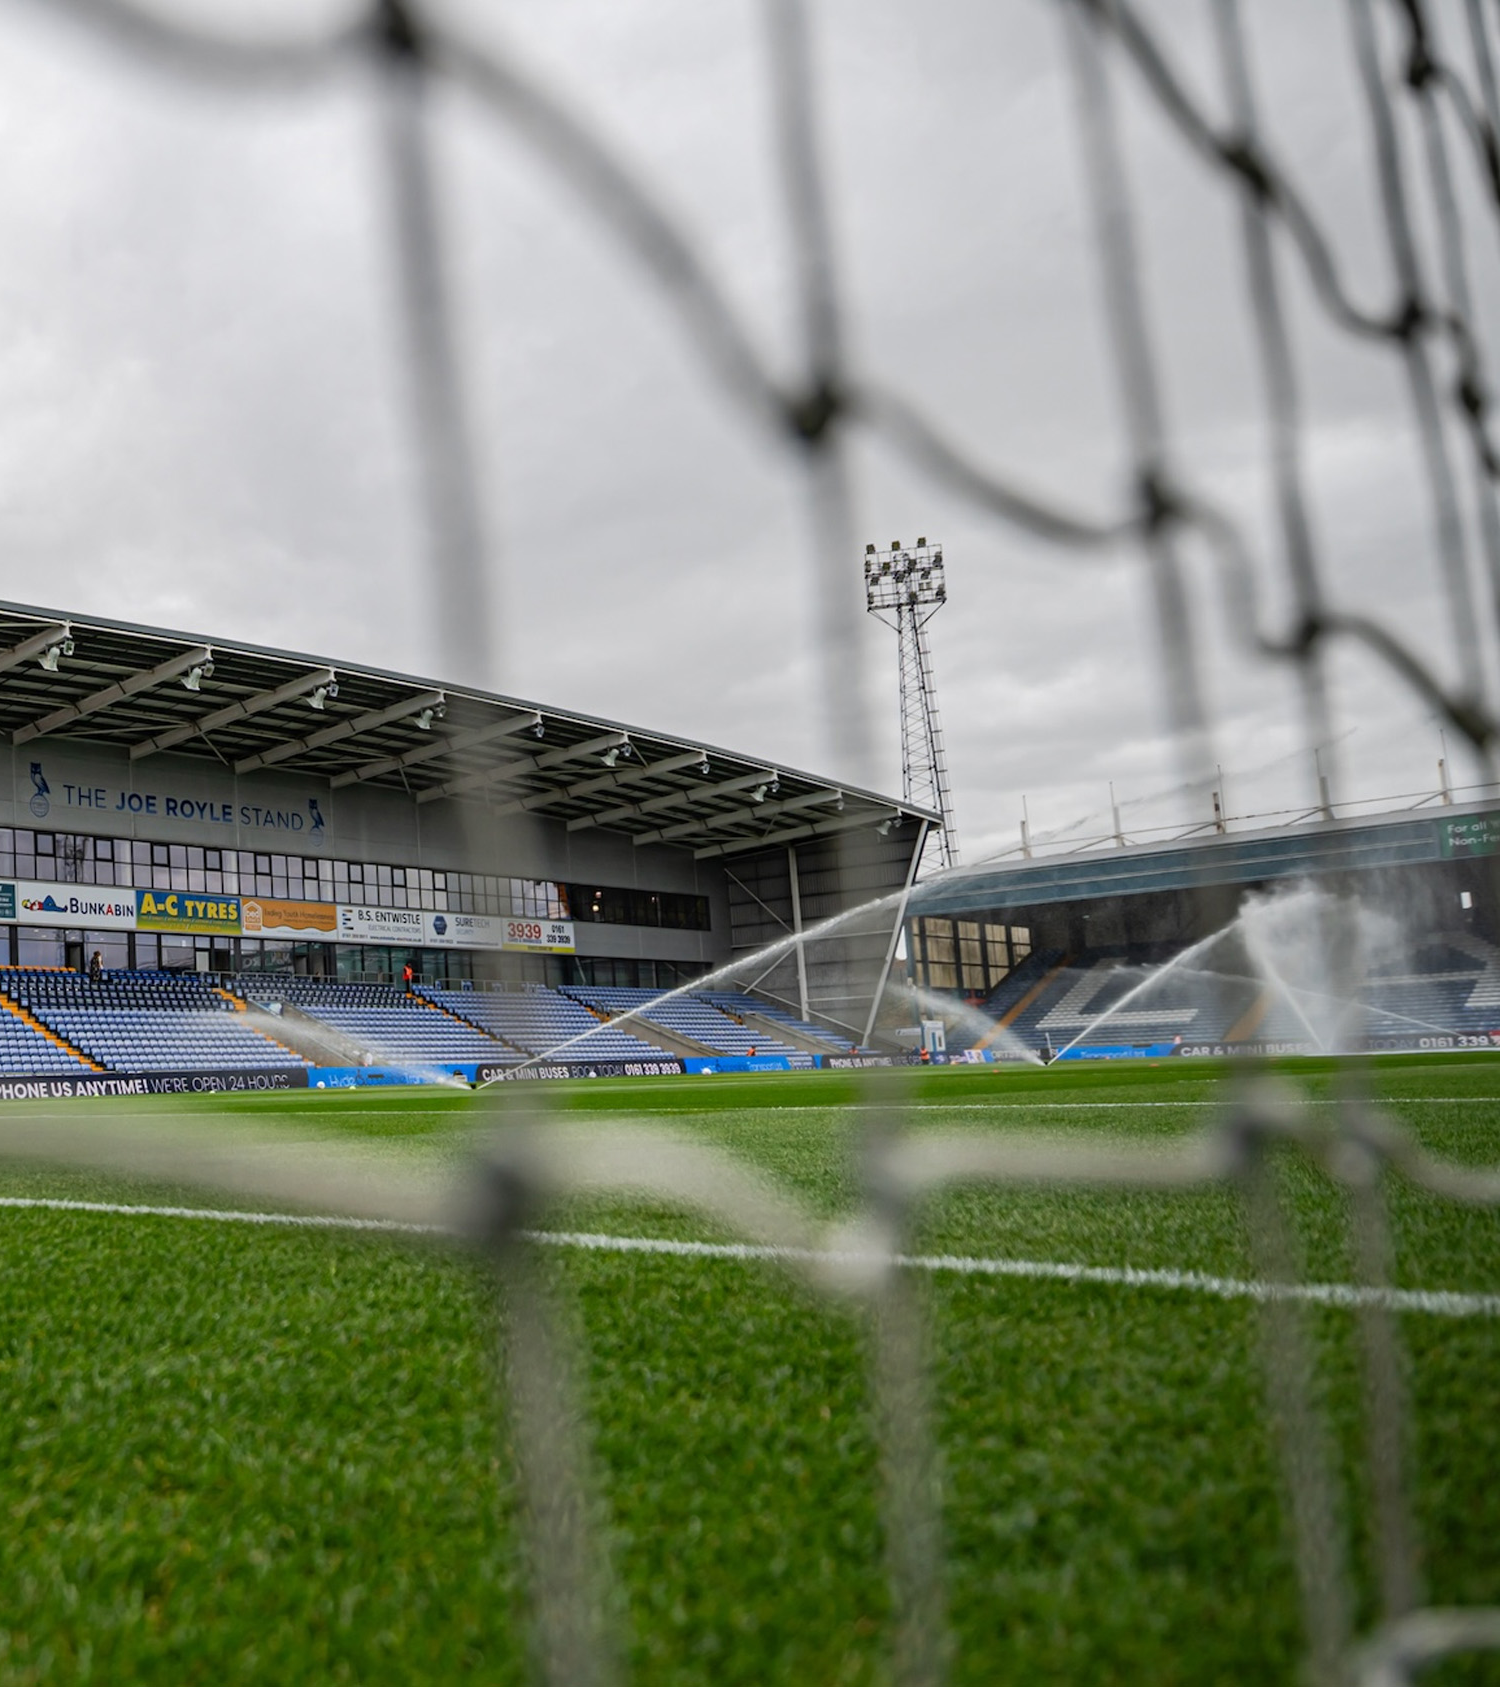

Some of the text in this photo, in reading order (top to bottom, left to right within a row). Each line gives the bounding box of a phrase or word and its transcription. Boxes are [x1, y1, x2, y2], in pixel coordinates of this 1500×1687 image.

[63, 785, 107, 809] THE
[115, 792, 157, 815] JOE
[166, 797, 234, 823] ROYLE
[240, 806, 304, 831] STAND
[140, 892, 238, 920] A-C TYRES
[358, 910, 421, 925] B.S. ENTWISTLE
[455, 917, 490, 928] SURETECH
[508, 923, 542, 940] 3939
[1180, 1046, 1211, 1057] CAR
[1213, 1046, 1223, 1056] &
[1420, 1036, 1453, 1048] 0161
[1457, 1035, 1490, 1047] 339
[482, 1068, 504, 1081] CAR
[516, 1067, 538, 1080] MINI
[539, 1066, 570, 1079] BUSES
[597, 1064, 624, 1077] TODAY
[624, 1063, 644, 1076] 0161
[643, 1063, 660, 1075] 339
[659, 1062, 682, 1074] 3939
[50, 1082, 73, 1097] US
[76, 1078, 150, 1097] ANYTIME!
[150, 1077, 190, 1094] WE'RE
[191, 1076, 227, 1092] OPEN
[229, 1075, 245, 1090] 24
